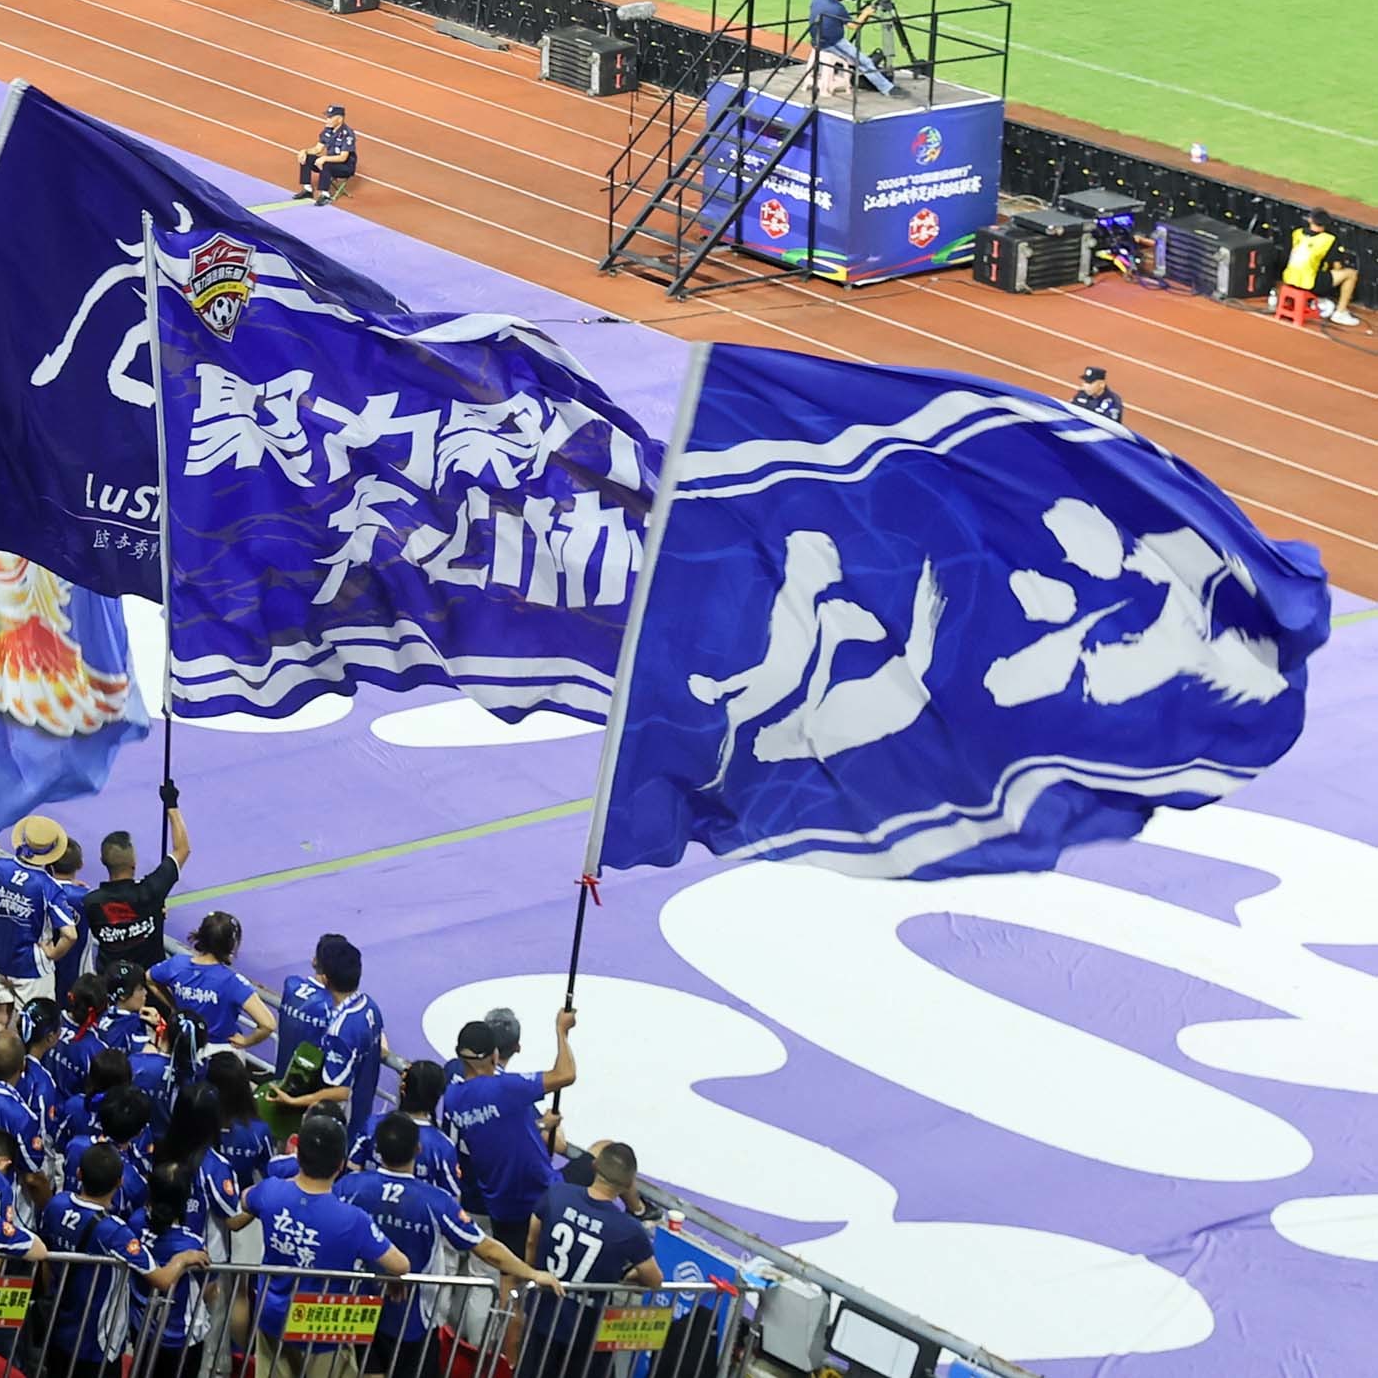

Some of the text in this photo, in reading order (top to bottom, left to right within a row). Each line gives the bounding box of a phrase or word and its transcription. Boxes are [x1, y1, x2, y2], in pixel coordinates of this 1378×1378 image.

[10, 869, 28, 887] 12
[382, 1182, 405, 1203] 12
[61, 1209, 82, 1229] 12
[547, 1221, 605, 1283] 37
